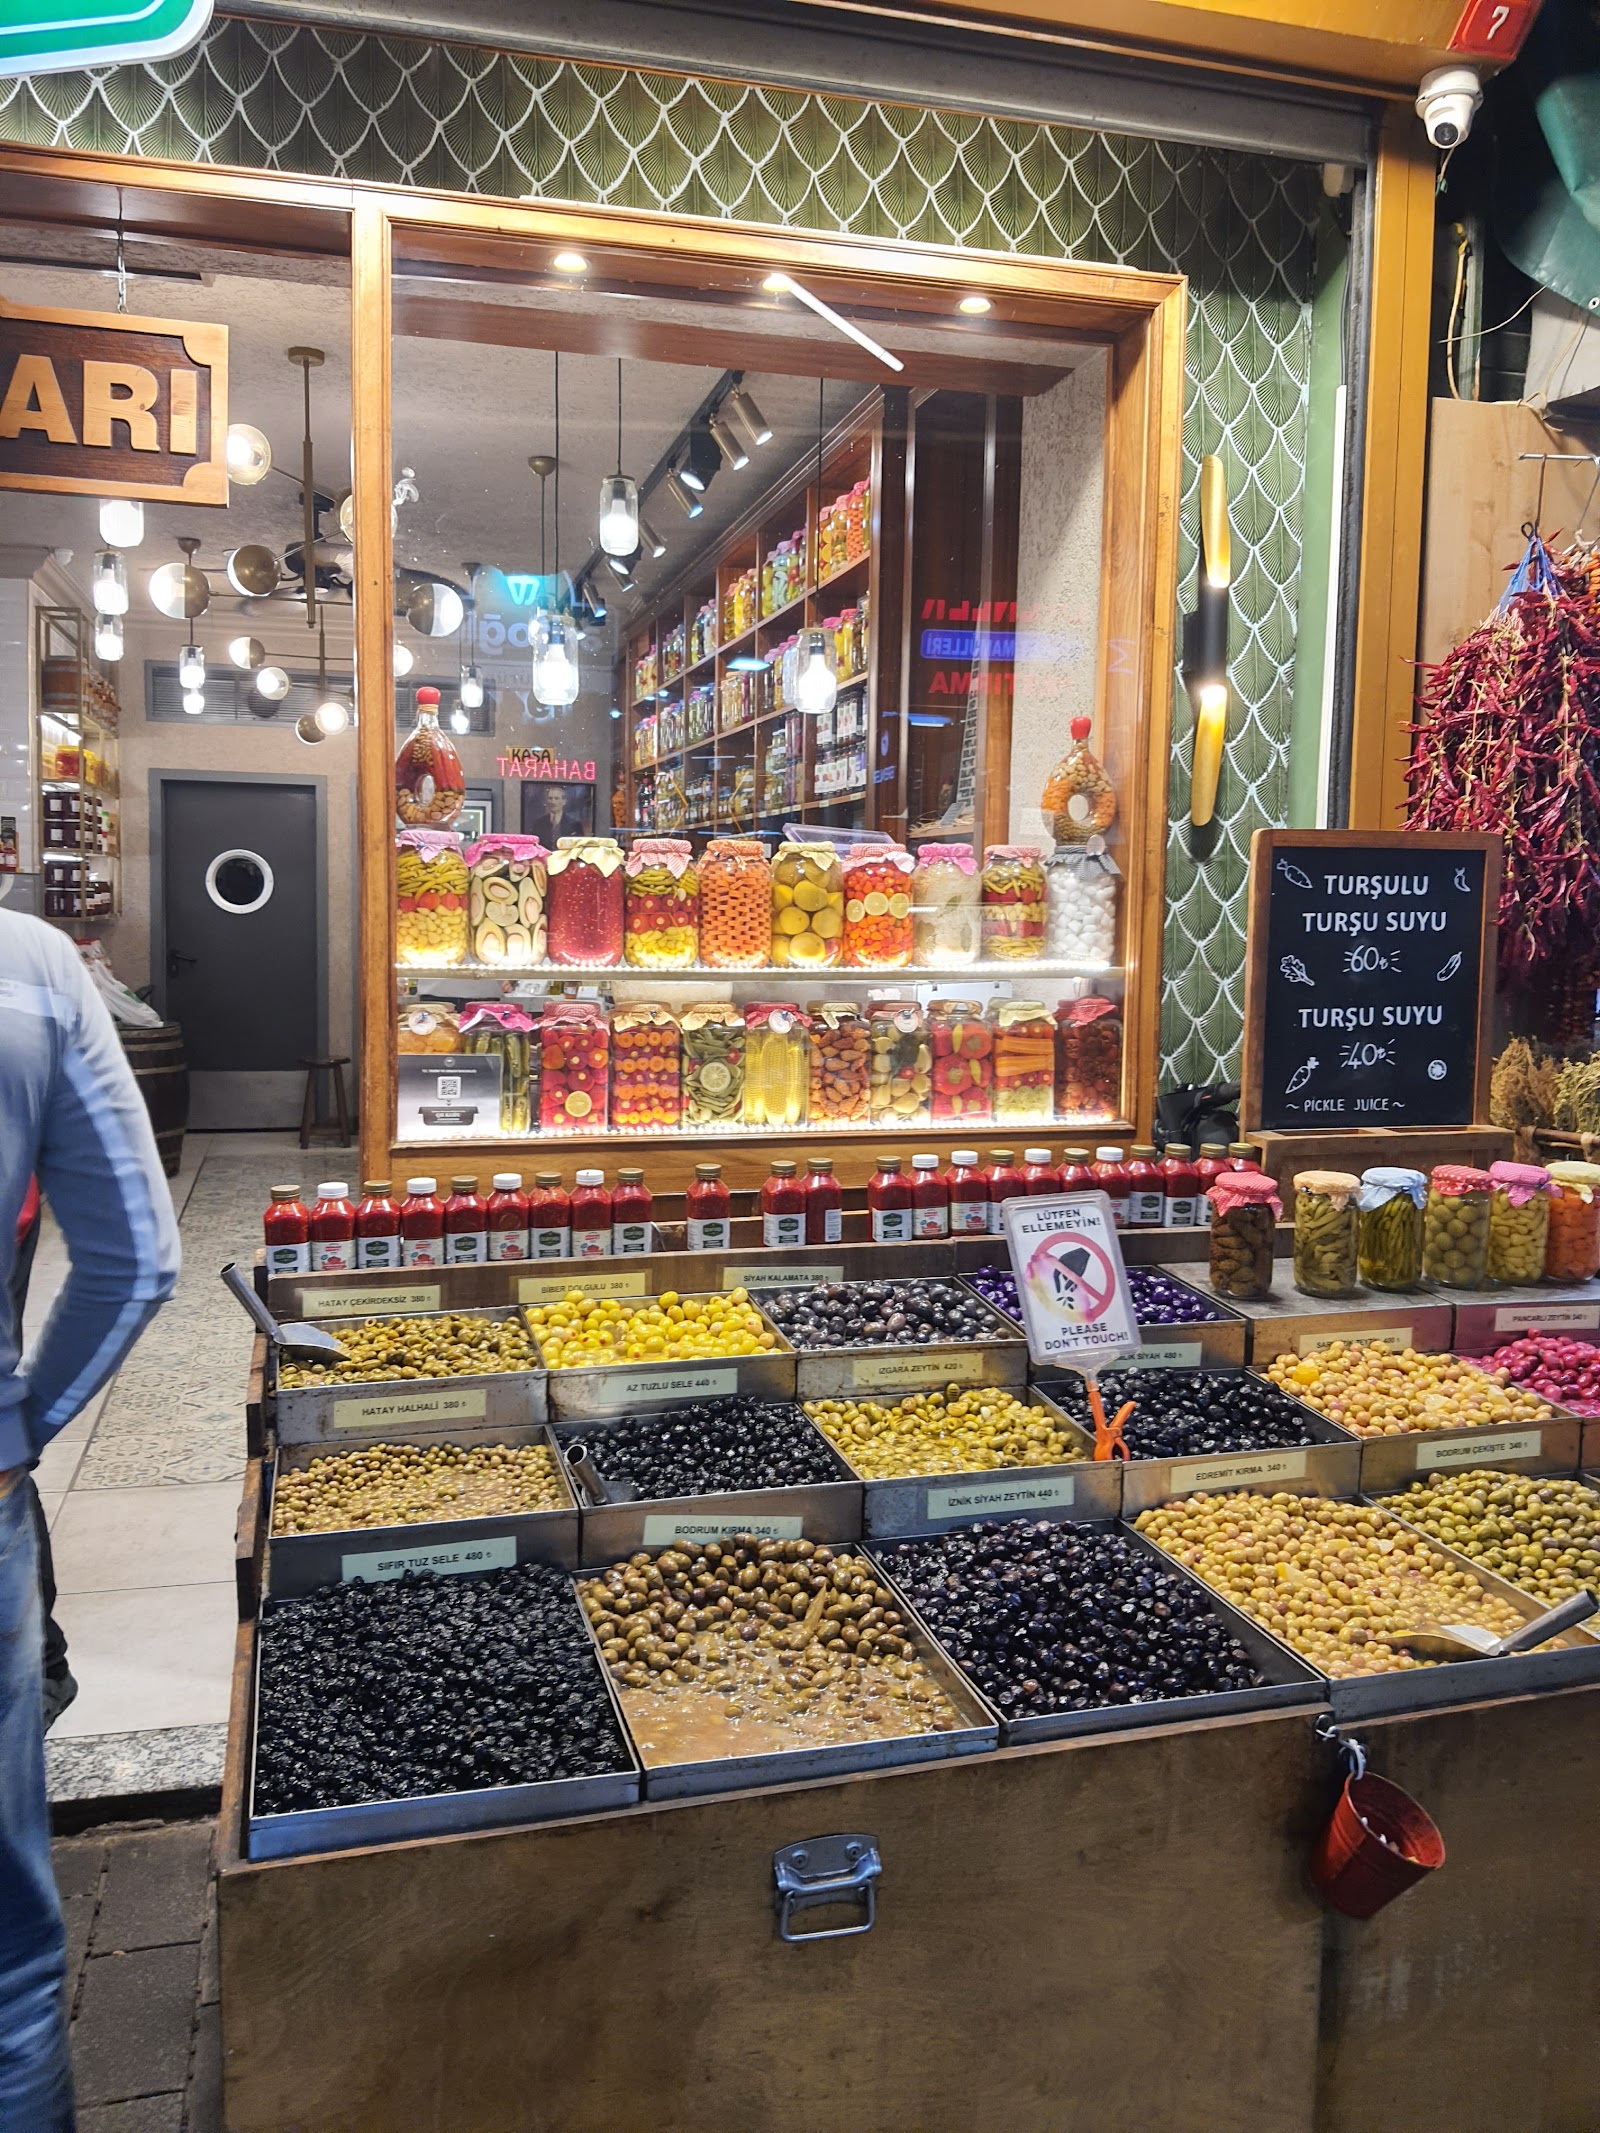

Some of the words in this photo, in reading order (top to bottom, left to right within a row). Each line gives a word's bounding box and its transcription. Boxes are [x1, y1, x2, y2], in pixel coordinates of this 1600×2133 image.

[1487, 6, 1510, 40] 7
[0, 353, 198, 455] ARI
[512, 749, 551, 763] KASA
[1324, 874, 1429, 900] TURŞULU
[1302, 912, 1379, 936] TURŞU
[1386, 911, 1447, 932] SUYU
[1298, 1006, 1375, 1032] TURŞU
[1382, 1004, 1443, 1027] SUYU
[1036, 1208, 1081, 1222] LÜTFEN
[1022, 1216, 1101, 1234] ELLEMEYİN!
[743, 1274, 766, 1282] SİYAH
[541, 1285, 565, 1294] BİBER
[567, 1283, 606, 1292] DOLGULU
[318, 1299, 348, 1308] HATAY
[350, 1295, 407, 1306] ÇEKİRDEKSİZ
[1061, 1322, 1108, 1336] PLEASE
[1045, 1337, 1080, 1351] DON'T
[1081, 1331, 1129, 1345] TOUCH!
[878, 1366, 909, 1375] IZGARA
[911, 1364, 939, 1372] ZEYTİN
[640, 1382, 668, 1391] TUZLU
[670, 1380, 693, 1389] SELE
[362, 1406, 394, 1416] HATAY
[398, 1401, 439, 1413] HALHALİ
[443, 1401, 459, 1409] 380
[1436, 1448, 1471, 1458] BODRUM
[1472, 1443, 1505, 1455] ÇEKİŞTE
[1195, 1468, 1234, 1481] EDREMİT
[1235, 1466, 1263, 1475] KIRMA
[1267, 1463, 1281, 1471] 340
[948, 1496, 972, 1507] İZNİK
[974, 1493, 1001, 1504] SİYAH
[1003, 1489, 1036, 1501] ZEYTİN
[1037, 1489, 1053, 1497] 440
[675, 1526, 718, 1535] BODRUM
[721, 1526, 752, 1535] KIRMA
[755, 1527, 771, 1535] 340
[377, 1561, 406, 1571] SIFIR
[408, 1557, 429, 1568] TUZ
[431, 1554, 459, 1565] SELE
[465, 1552, 483, 1561] 480
